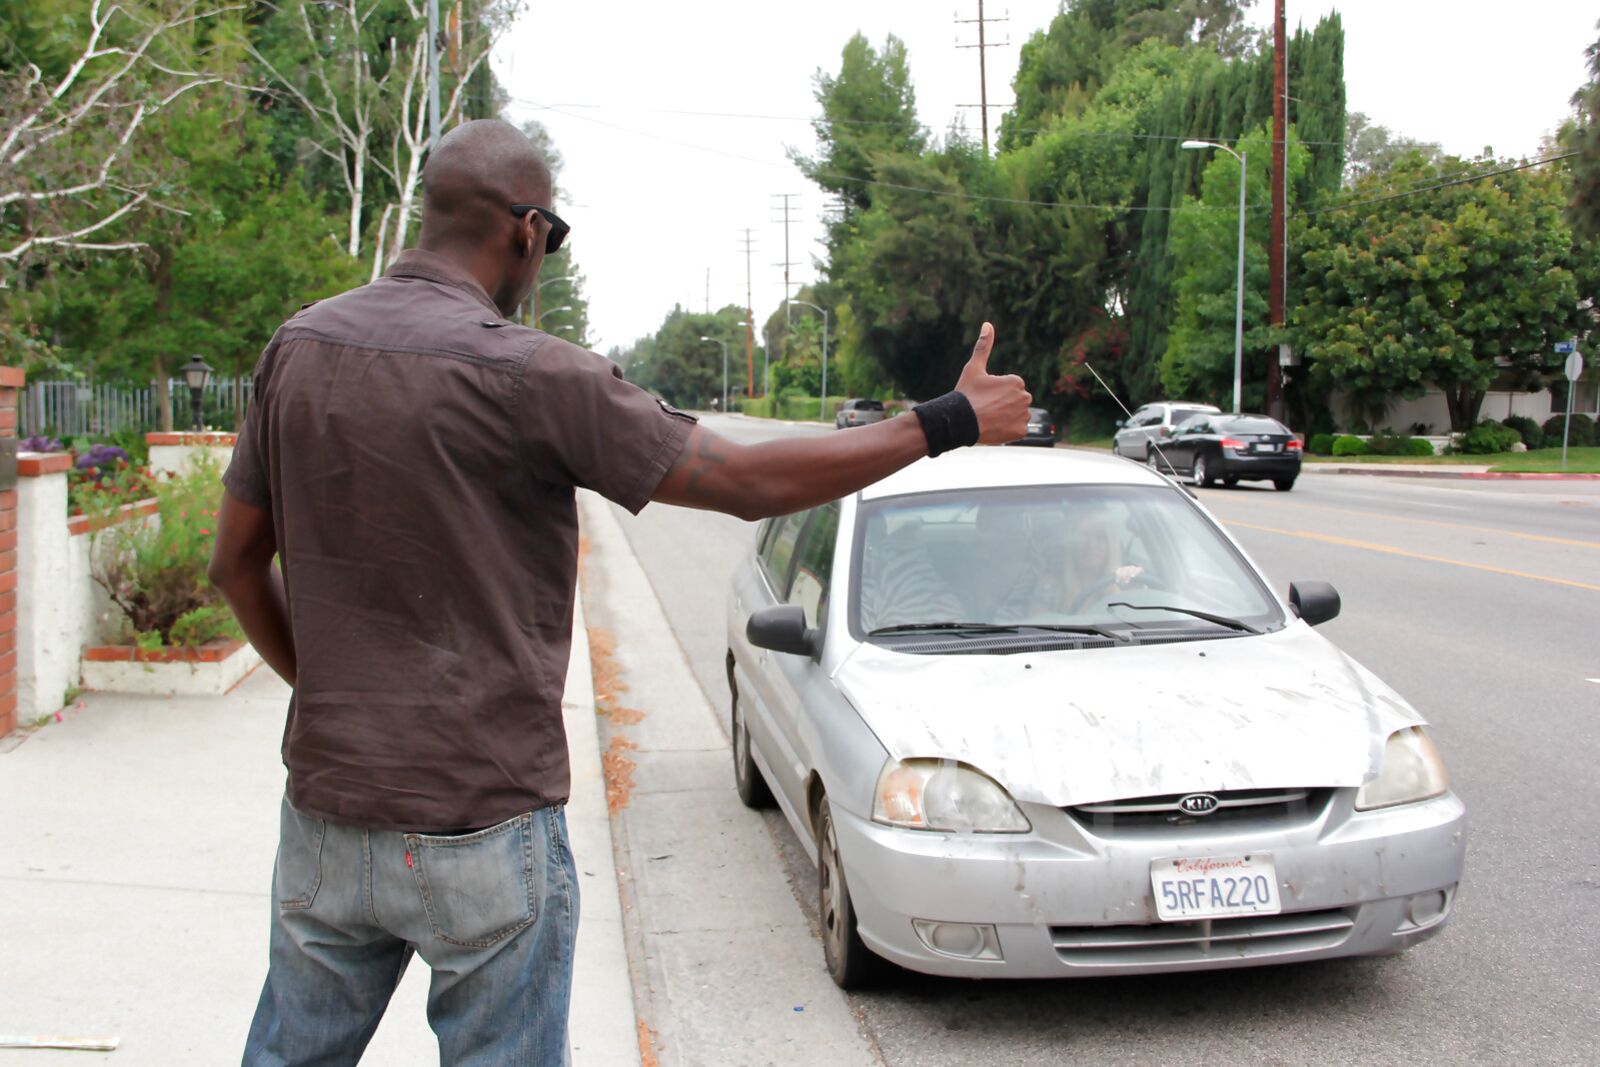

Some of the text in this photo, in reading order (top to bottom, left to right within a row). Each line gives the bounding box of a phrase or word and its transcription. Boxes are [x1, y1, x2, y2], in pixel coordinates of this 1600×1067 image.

[1186, 798, 1213, 810] KIA
[1176, 857, 1251, 875] California
[1161, 875, 1271, 911] 5RFA220
